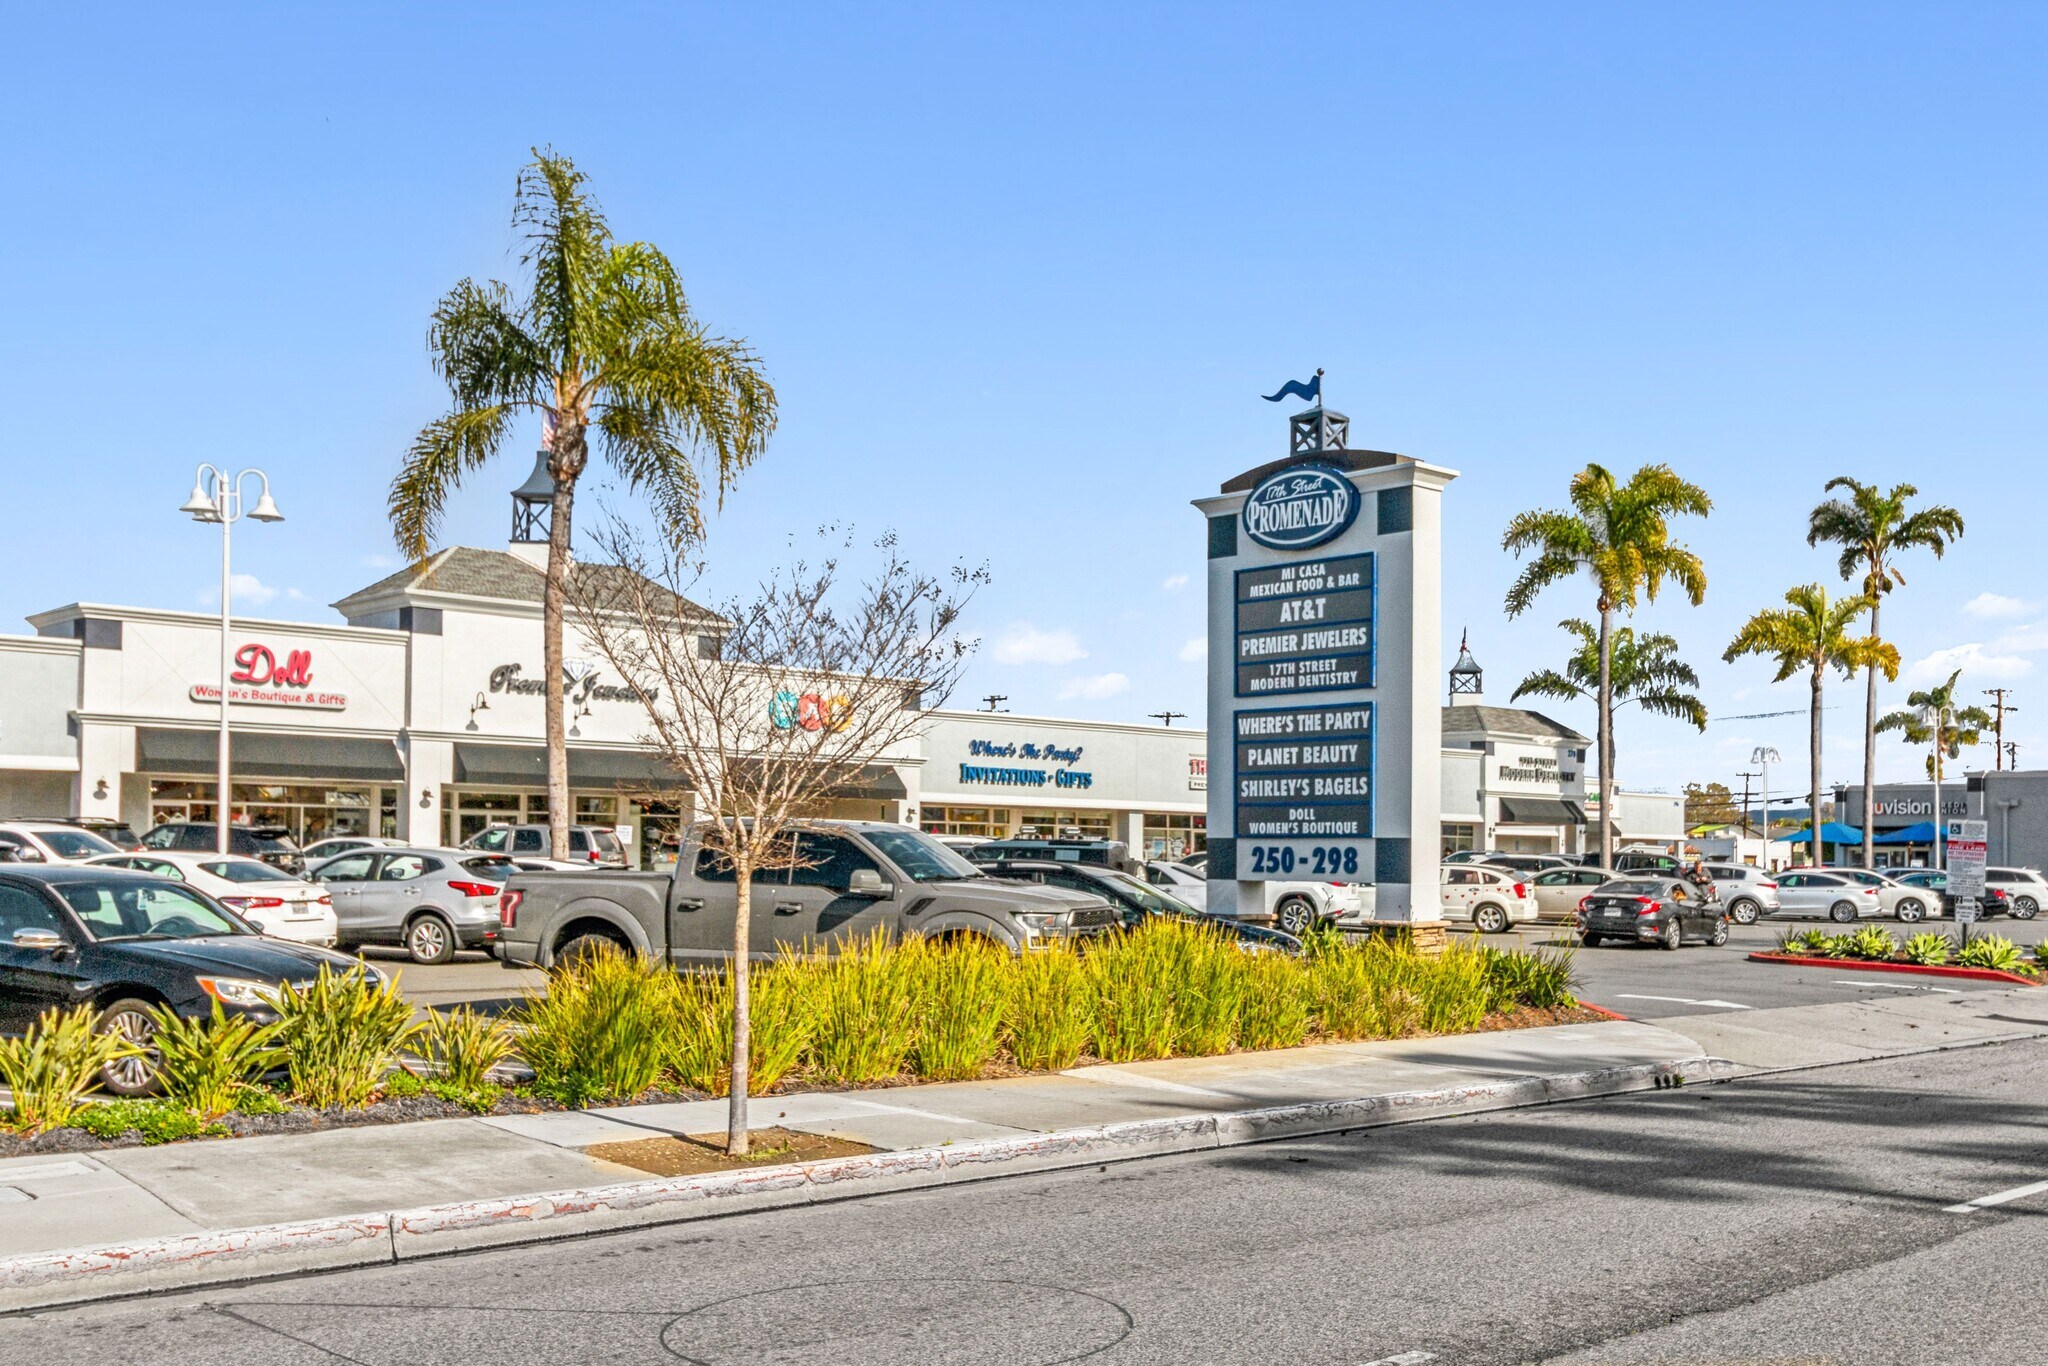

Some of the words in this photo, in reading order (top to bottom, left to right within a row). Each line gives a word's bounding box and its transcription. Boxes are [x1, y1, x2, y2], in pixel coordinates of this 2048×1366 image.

[1265, 483, 1287, 500] 17th
[1291, 476, 1324, 495] Street
[1248, 490, 1344, 534] PROMENADE
[1281, 567, 1295, 580] MI
[1299, 563, 1326, 578] CASA
[1250, 581, 1293, 597] MEXICAN
[1296, 578, 1323, 592] FOOD
[1326, 576, 1335, 588] &
[1338, 573, 1360, 587] BAR
[1280, 598, 1326, 622] AT&T
[1241, 634, 1298, 656] PREMIER
[1301, 627, 1367, 651] JEWELERS
[231, 643, 313, 687] Doll
[1269, 662, 1295, 676] 17TH
[1299, 659, 1337, 673] STREET
[1250, 676, 1295, 691] MODERN
[1298, 671, 1358, 687] DENTISTRY
[251, 691, 301, 704] Boutique
[305, 694, 315, 703] &
[319, 694, 345, 705] Gifts
[1238, 715, 1294, 735] WHERE'S
[1297, 714, 1321, 732] THE
[1325, 711, 1370, 731] PARTY
[1247, 747, 1298, 766] PLANET
[1303, 744, 1358, 763] BEAUTY
[1189, 759, 1207, 775] TH
[1241, 778, 1310, 797] SHIRLEY'S
[1314, 777, 1368, 795] BAGELS
[1289, 808, 1315, 820] DOLL
[1874, 799, 1931, 814] uvision
[1249, 822, 1299, 834] WOMEN'S
[1302, 822, 1358, 834] BOUTIQUE
